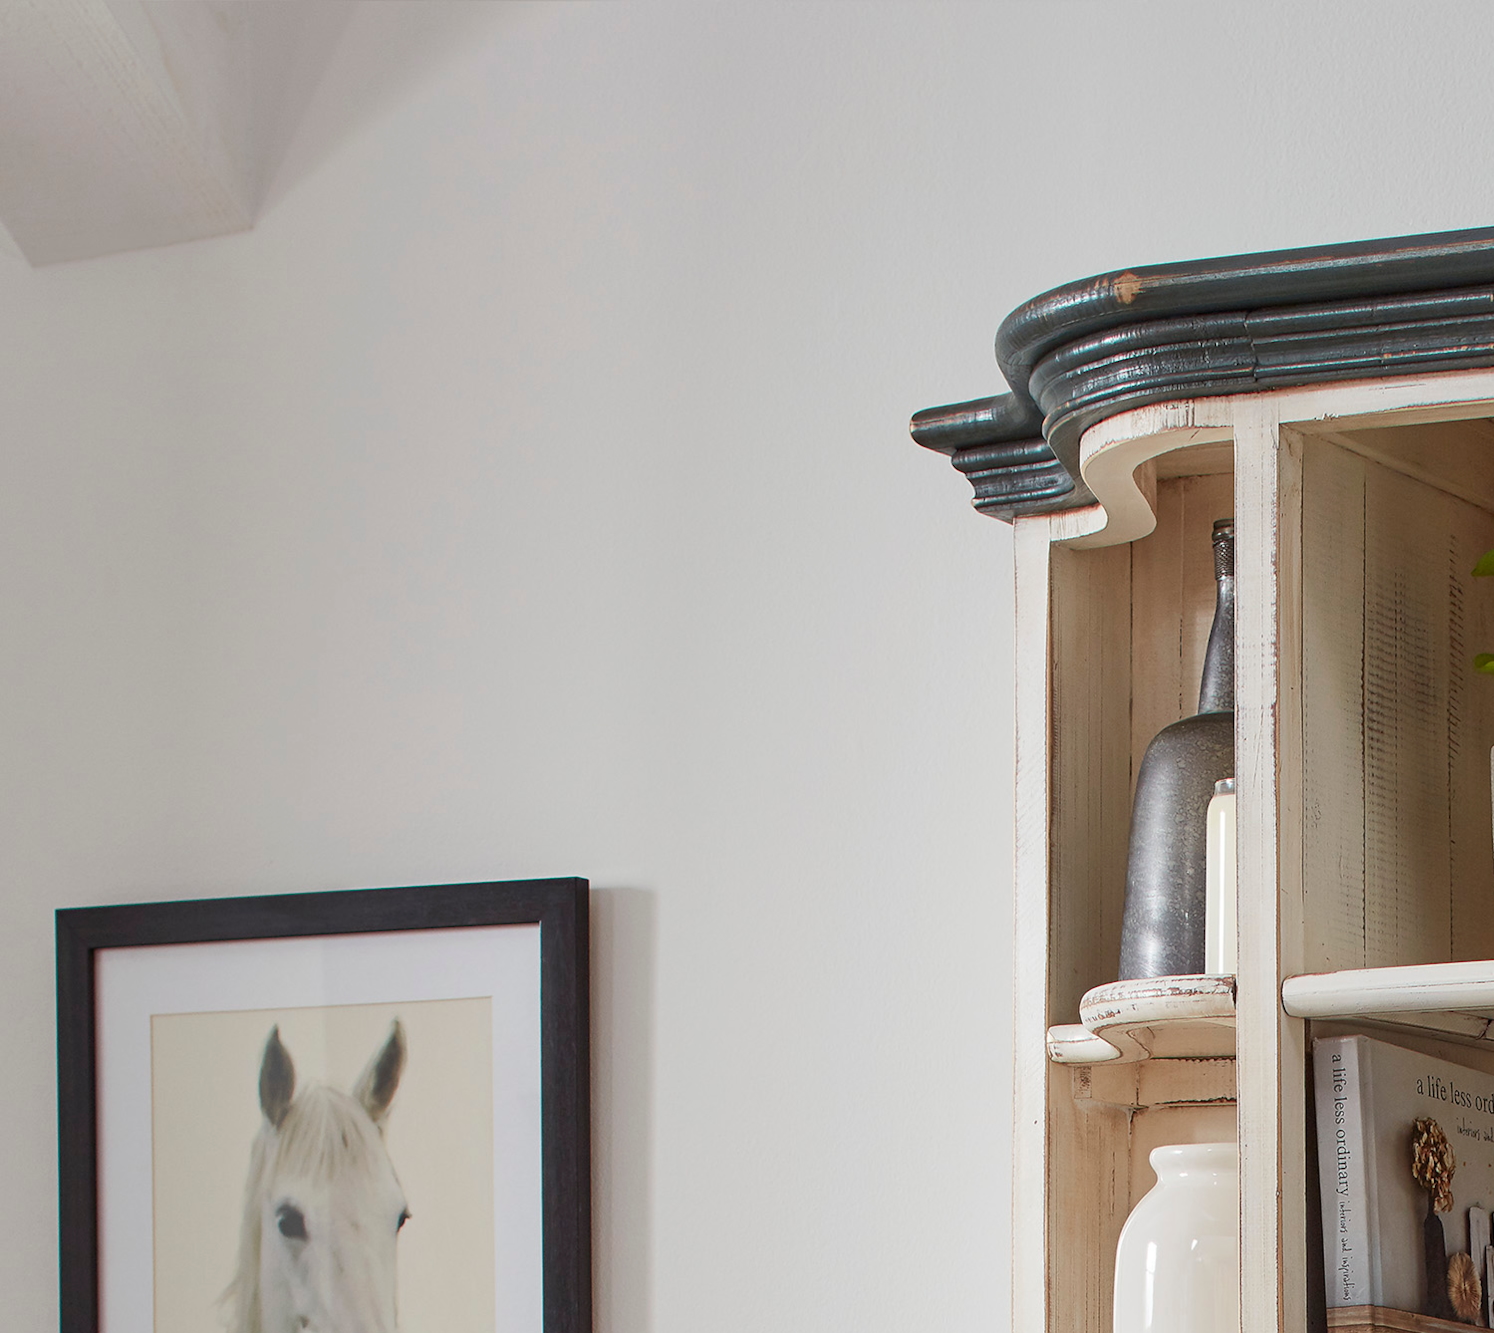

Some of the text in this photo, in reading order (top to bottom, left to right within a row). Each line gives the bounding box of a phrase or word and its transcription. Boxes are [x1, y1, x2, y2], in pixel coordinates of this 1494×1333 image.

[1416, 1078, 1424, 1096] a
[1427, 1075, 1447, 1102] life
[1450, 1082, 1472, 1109] less
[1483, 1127, 1494, 1143] and
[1332, 1054, 1355, 1301] a life less ordinary interiors and inspirations
